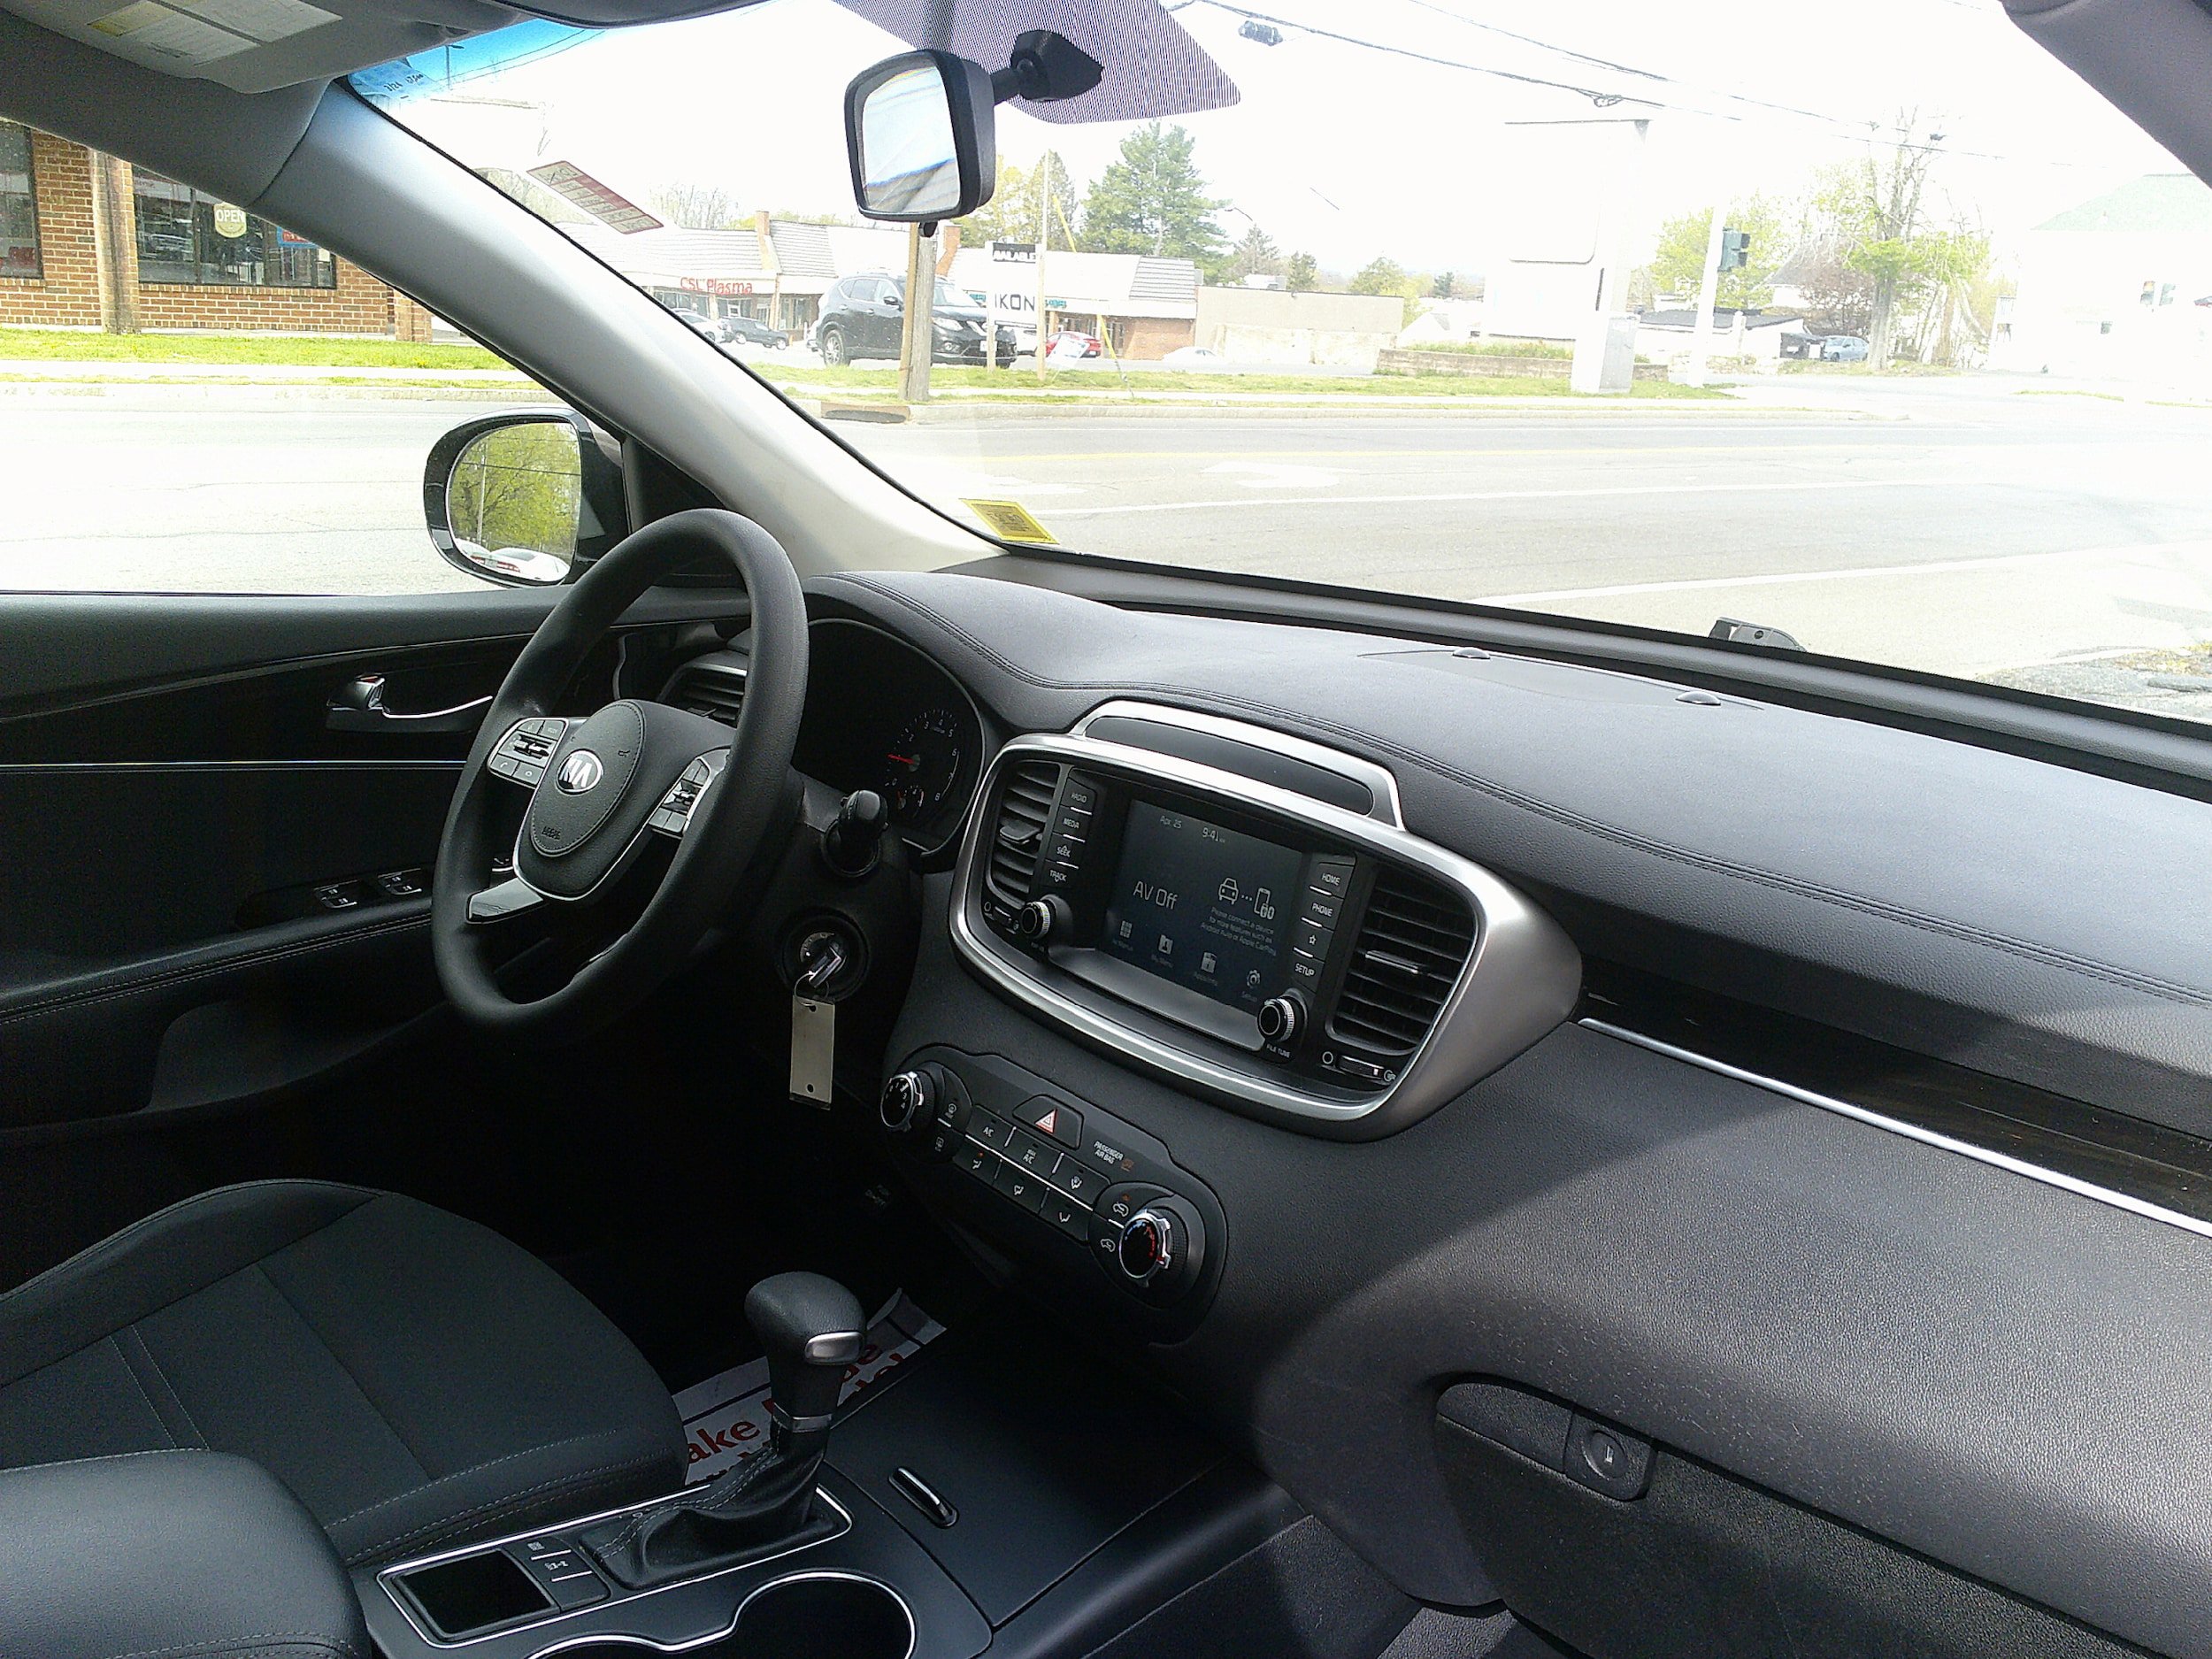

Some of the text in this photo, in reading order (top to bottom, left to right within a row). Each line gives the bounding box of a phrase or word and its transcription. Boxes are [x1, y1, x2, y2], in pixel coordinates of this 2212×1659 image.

[215, 209, 247, 223] OPEN
[680, 276, 753, 296] CSL Plasma
[995, 293, 1036, 311] IKON
[1063, 817, 1079, 829] MEDIA
[1056, 845, 1071, 858] SEEK
[1049, 869, 1067, 882] TRACK
[1321, 872, 1340, 886] HOME
[1133, 880, 1179, 910] AV Off
[1311, 902, 1333, 918] PHONE
[1294, 963, 1315, 977] SETUP
[1094, 1141, 1125, 1161] PASSENGER
[1094, 1149, 1105, 1159] AIR
[1103, 1153, 1115, 1164] BAG
[687, 1420, 762, 1464] ake
